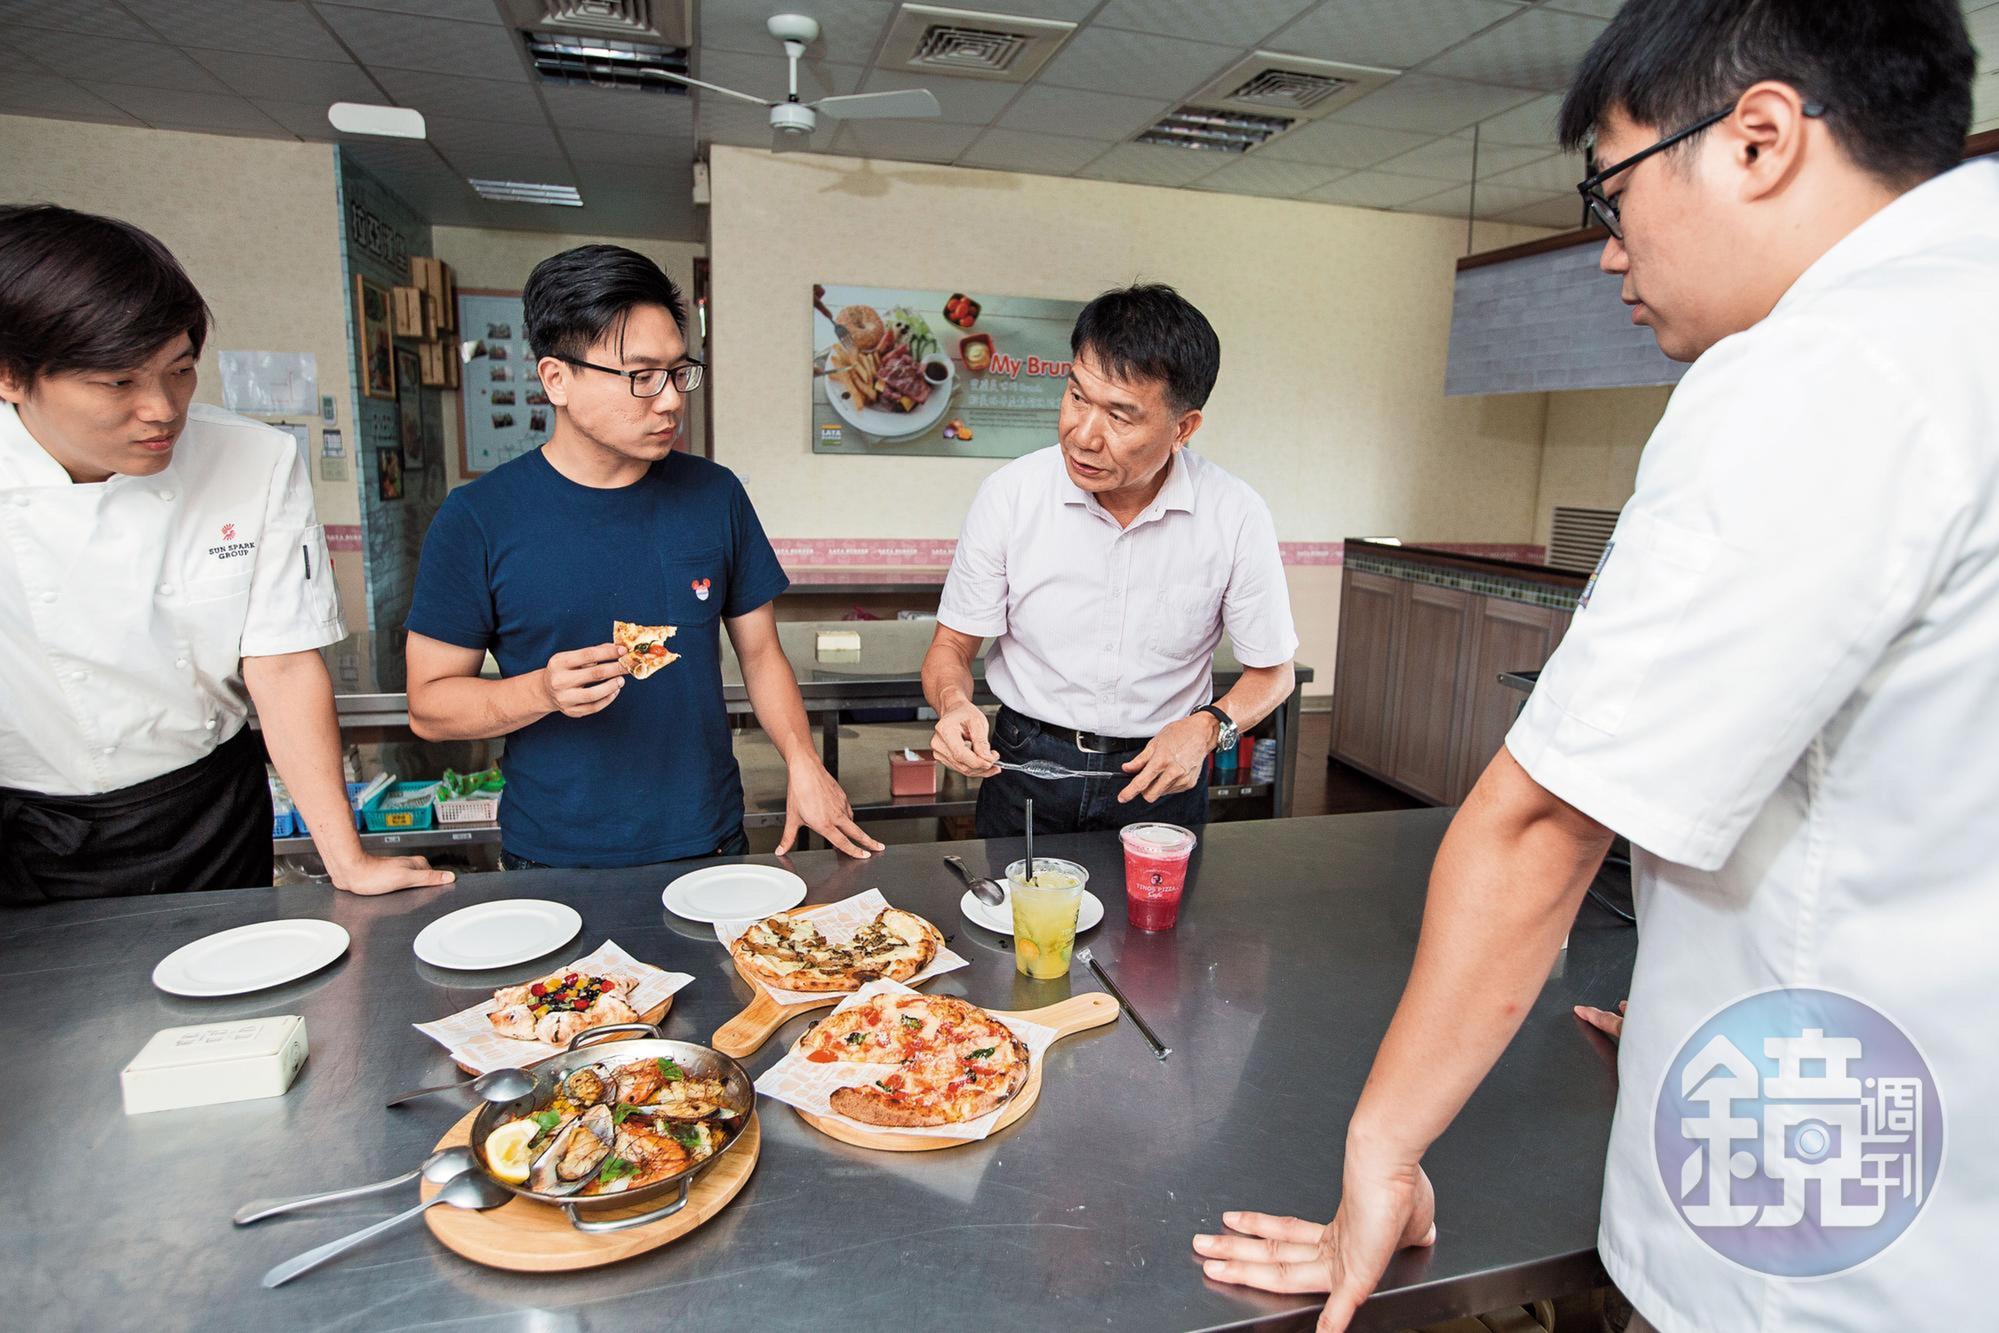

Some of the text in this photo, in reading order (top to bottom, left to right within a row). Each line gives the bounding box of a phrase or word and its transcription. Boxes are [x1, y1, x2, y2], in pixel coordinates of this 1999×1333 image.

[989, 353, 1022, 380] My
[208, 542, 256, 555] SUN SPARK
[218, 549, 249, 560] GROUP
